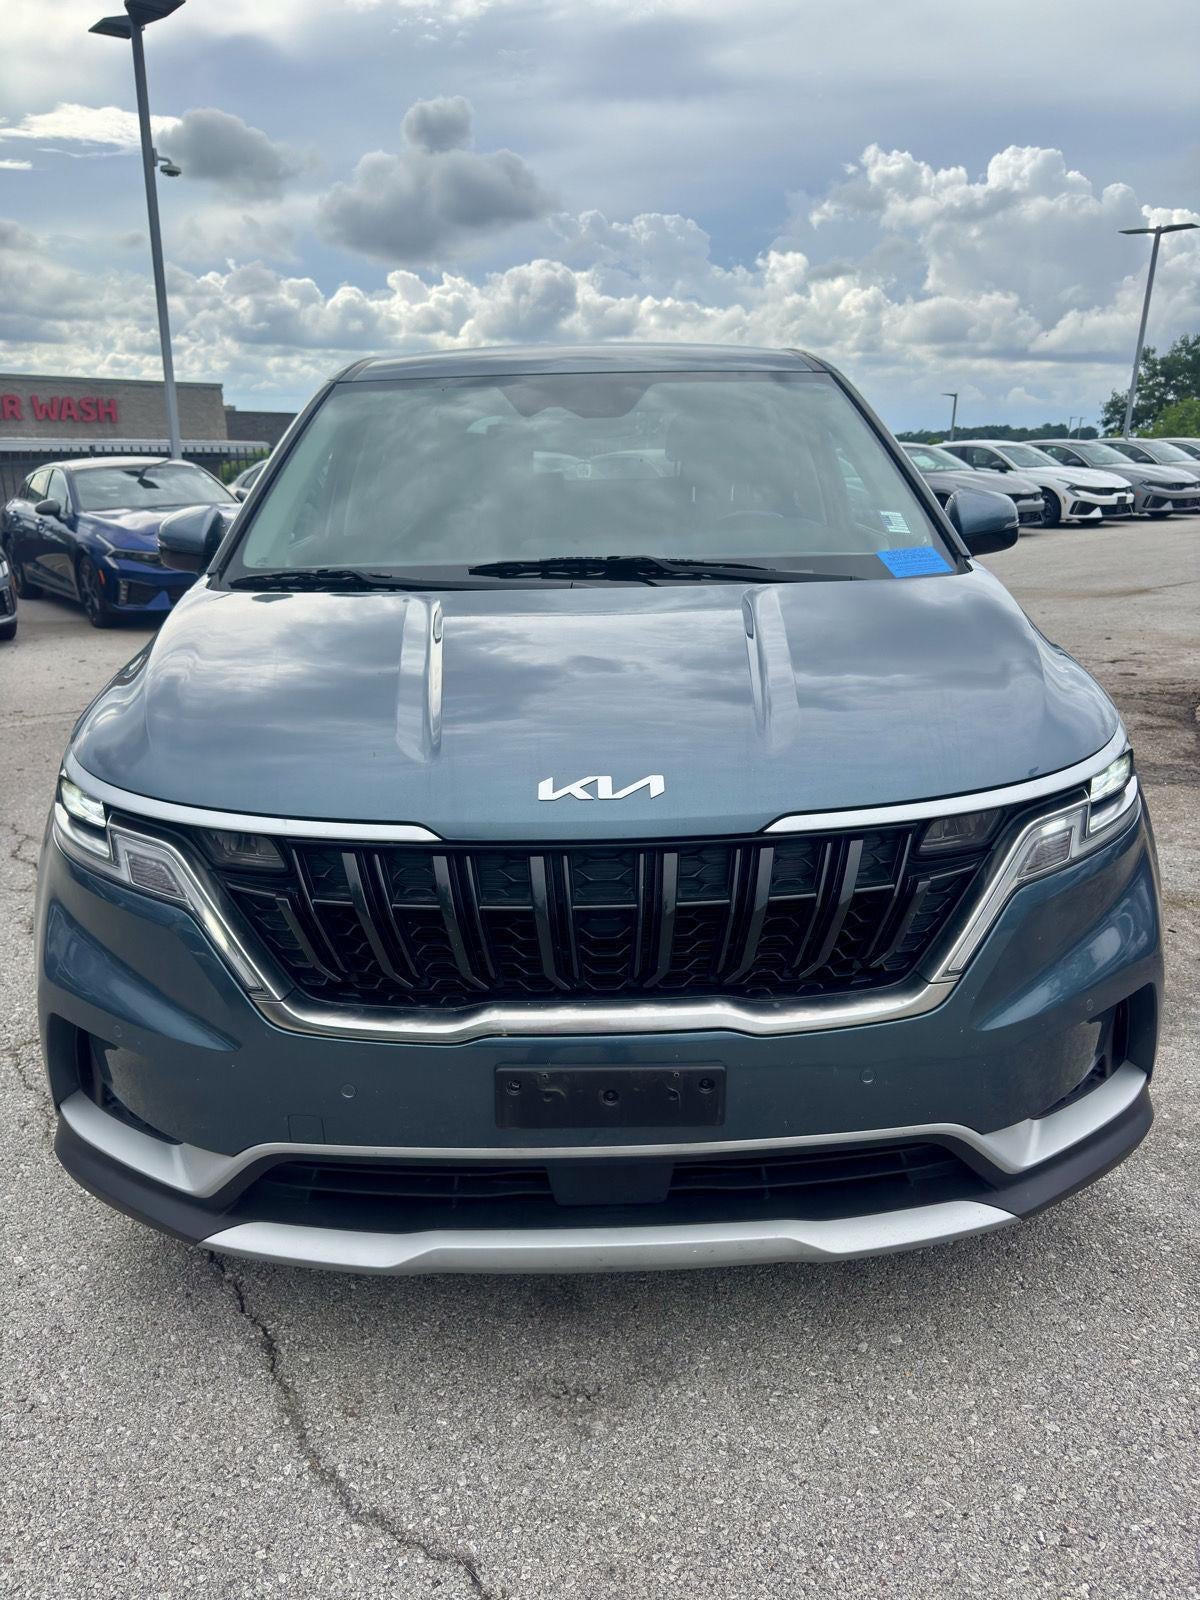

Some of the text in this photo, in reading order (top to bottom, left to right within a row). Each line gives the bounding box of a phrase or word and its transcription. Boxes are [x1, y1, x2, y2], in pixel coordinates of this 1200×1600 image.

[0, 394, 118, 422] R WASH
[538, 774, 665, 801] KIA
